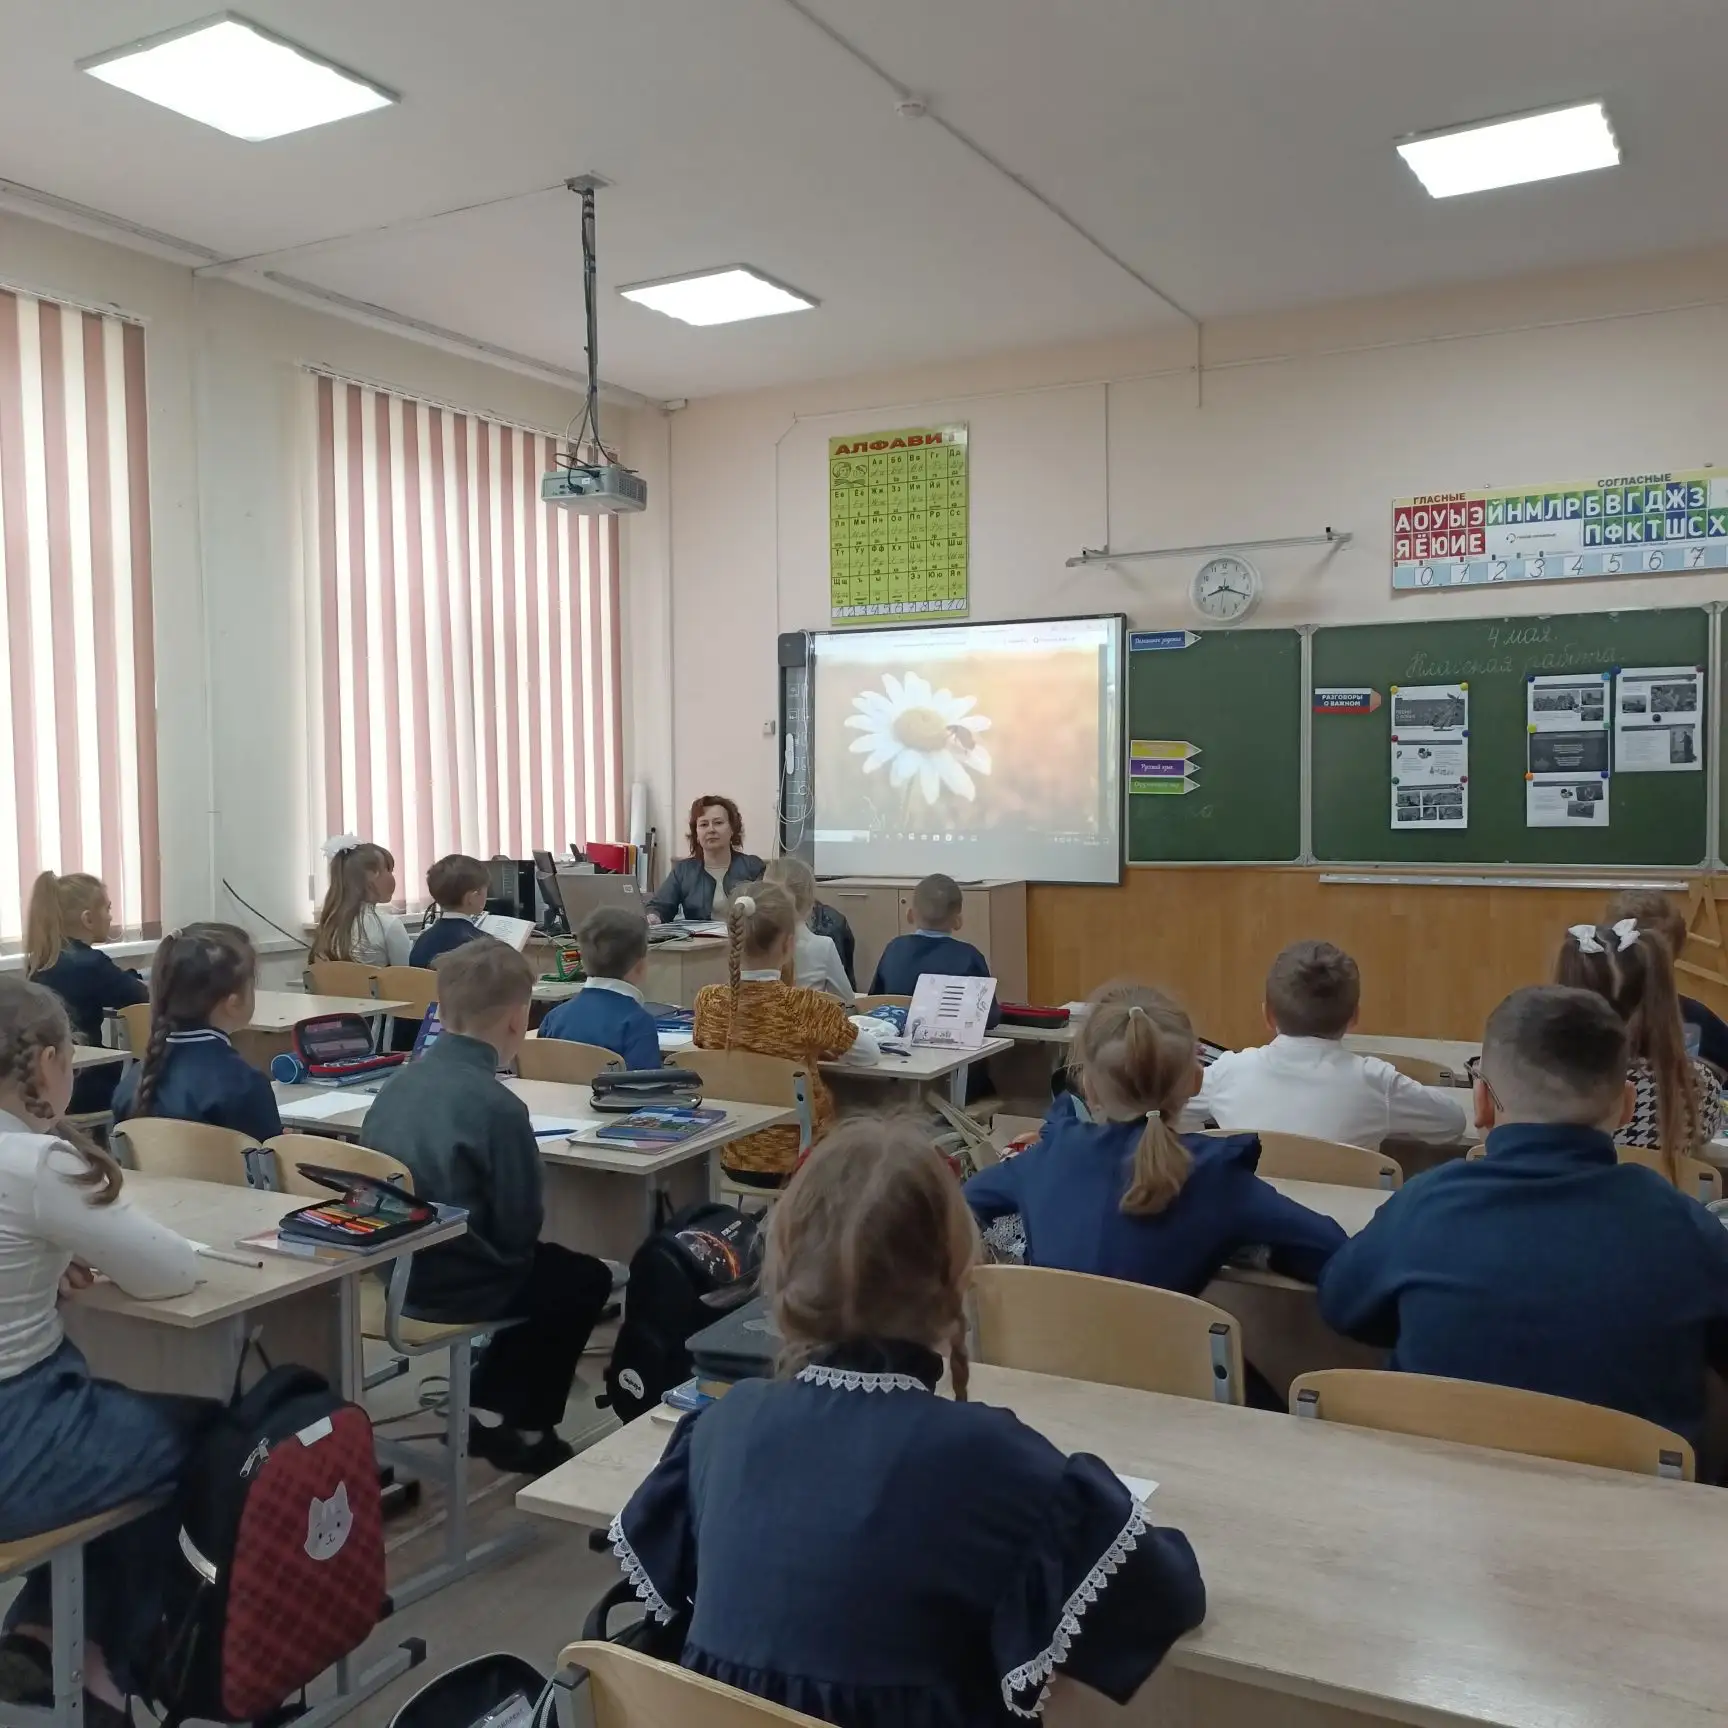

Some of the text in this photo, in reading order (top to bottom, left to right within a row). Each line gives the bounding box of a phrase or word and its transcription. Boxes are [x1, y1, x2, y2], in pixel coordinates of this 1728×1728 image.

[834, 432, 956, 455] АЛФАВИ
[1597, 473, 1672, 488] СОГЛАСНЫЕ
[1413, 493, 1466, 505] ГЛАСНЫЕ
[1420, 547, 1705, 586] 0 1 2 3 4 5 6 7
[1488, 625, 1498, 648] 4
